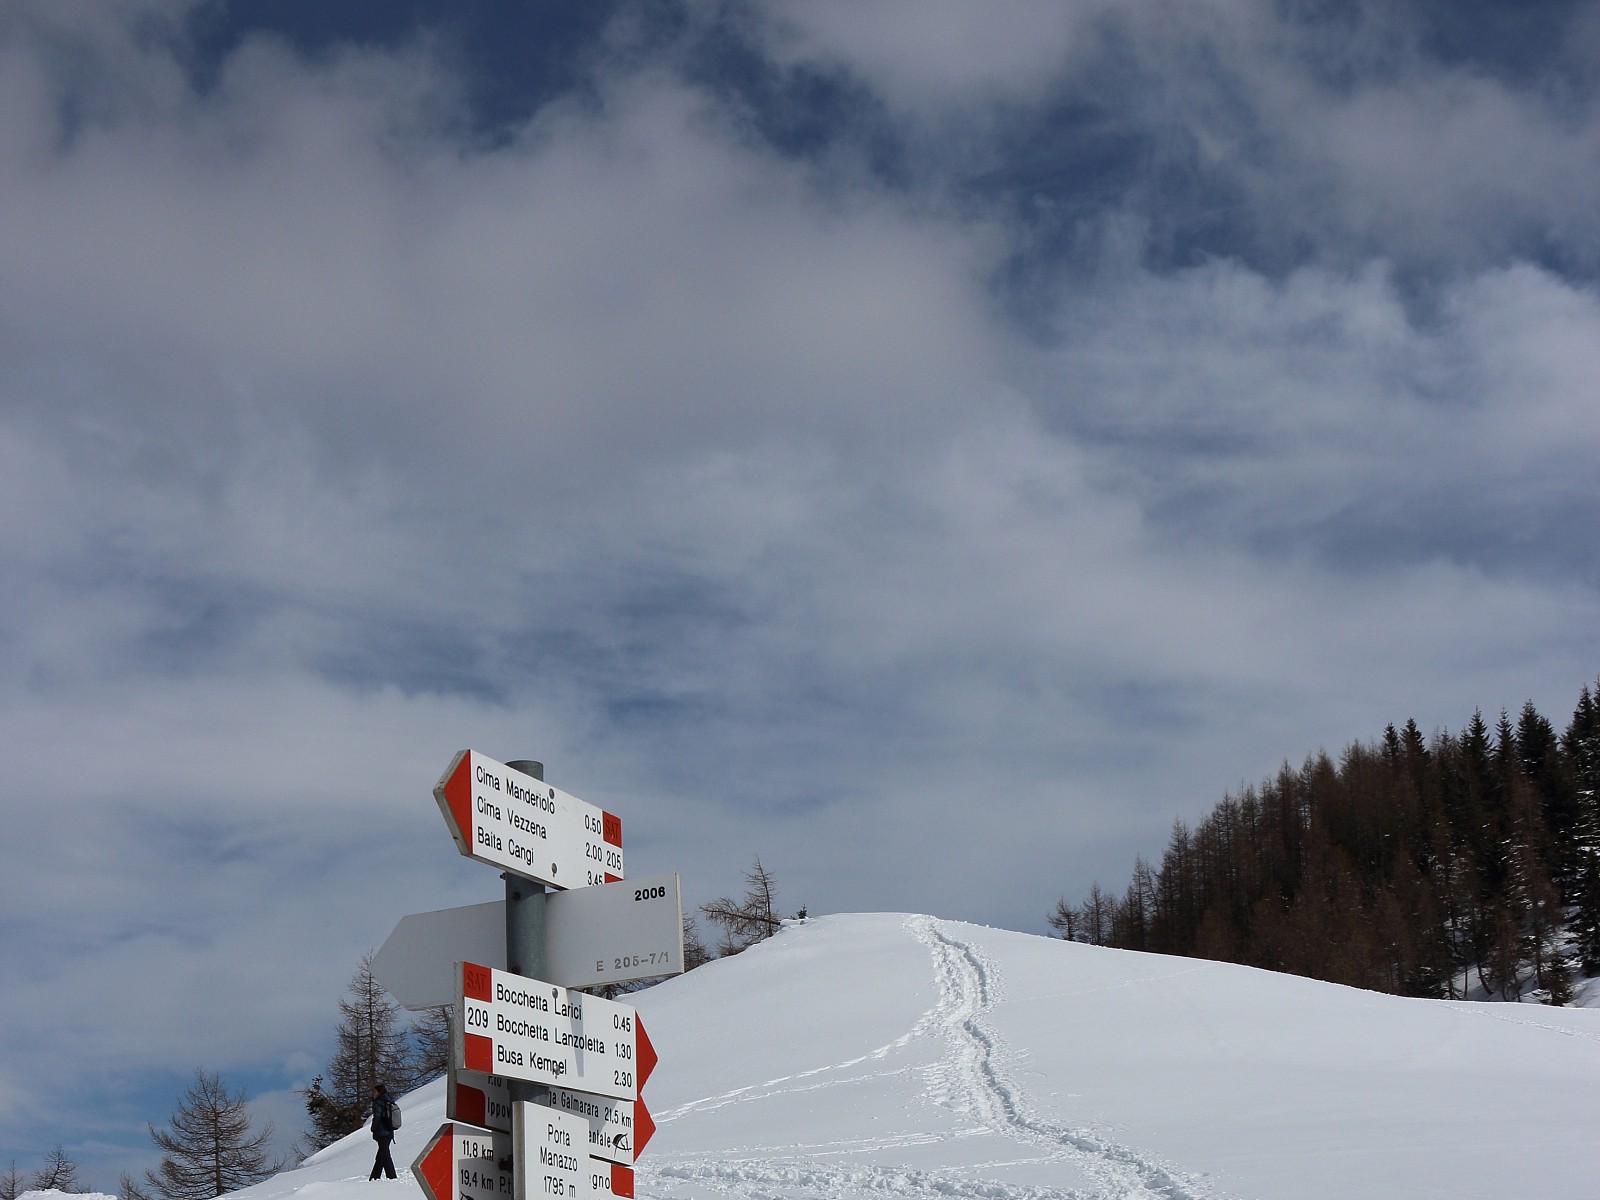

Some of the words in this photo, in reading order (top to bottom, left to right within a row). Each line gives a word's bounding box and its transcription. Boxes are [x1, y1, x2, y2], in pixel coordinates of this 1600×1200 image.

[476, 766, 501, 791] Cima
[506, 778, 555, 815] Manderiolo
[585, 814, 602, 835] 0.50
[604, 821, 619, 840] SAT
[477, 796, 501, 821] Cima
[507, 808, 547, 840] Vezzena
[585, 842, 602, 862] 2.00
[606, 851, 622, 871] 205
[477, 826, 502, 851] Baita
[508, 839, 534, 866] Cangi
[634, 886, 666, 901] 2006
[596, 961, 604, 972] E
[614, 951, 669, 969] 205-7/1
[467, 971, 486, 993] SAT
[497, 983, 549, 1013] Bocchetta
[554, 998, 582, 1021] Larici
[613, 1014, 631, 1033] 0.45
[467, 1007, 489, 1028] 209
[497, 1014, 549, 1041] Bocchetta
[555, 1028, 605, 1054] Lanzoletta
[615, 1044, 632, 1060] 1.30
[498, 1045, 523, 1066] Busa
[529, 1051, 567, 1075] Kempel
[614, 1070, 632, 1088] 2.30
[488, 1097, 510, 1118] Ippov
[589, 1130, 611, 1148] entale
[561, 1091, 599, 1118] Galmarara
[604, 1106, 619, 1124] 21,5
[622, 1112, 632, 1128] km
[547, 1124, 571, 1147] Porta
[462, 1139, 479, 1158] 11,8
[481, 1144, 494, 1162] km
[591, 1174, 611, 1190] gno
[540, 1146, 578, 1172] Manazzo
[460, 1169, 478, 1188] 19,4
[481, 1174, 494, 1191] km
[500, 1176, 511, 1194] P.t
[544, 1176, 565, 1196] 1795
[569, 1183, 576, 1198] m
